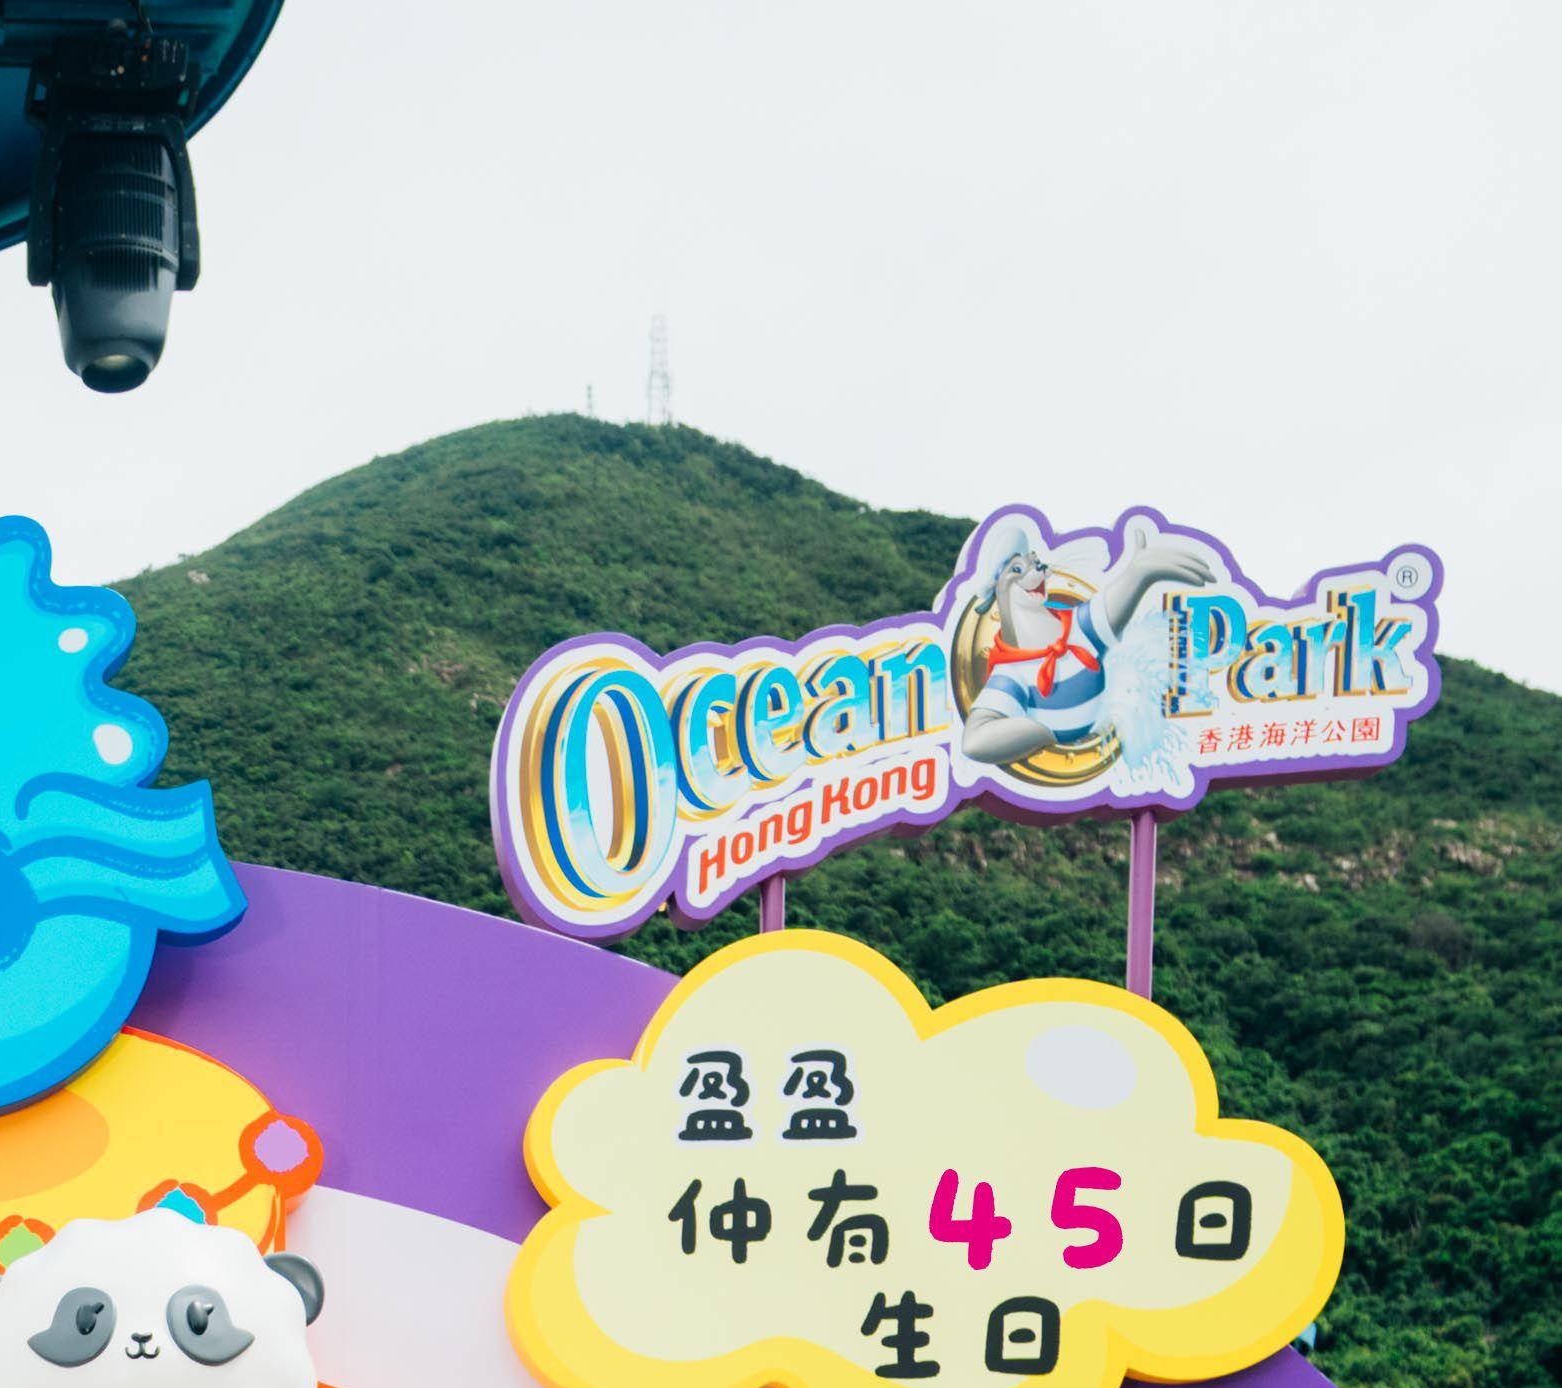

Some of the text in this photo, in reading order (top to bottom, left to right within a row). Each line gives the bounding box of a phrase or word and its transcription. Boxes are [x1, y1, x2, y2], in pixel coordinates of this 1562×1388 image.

[519, 636, 955, 912] Ocean
[1163, 585, 1414, 718] Park
[1198, 716, 1381, 755] 香港海洋公園
[699, 757, 937, 895] Hong Kong
[678, 1050, 858, 1141] 盈盈
[860, 1290, 1061, 1379] 生日
